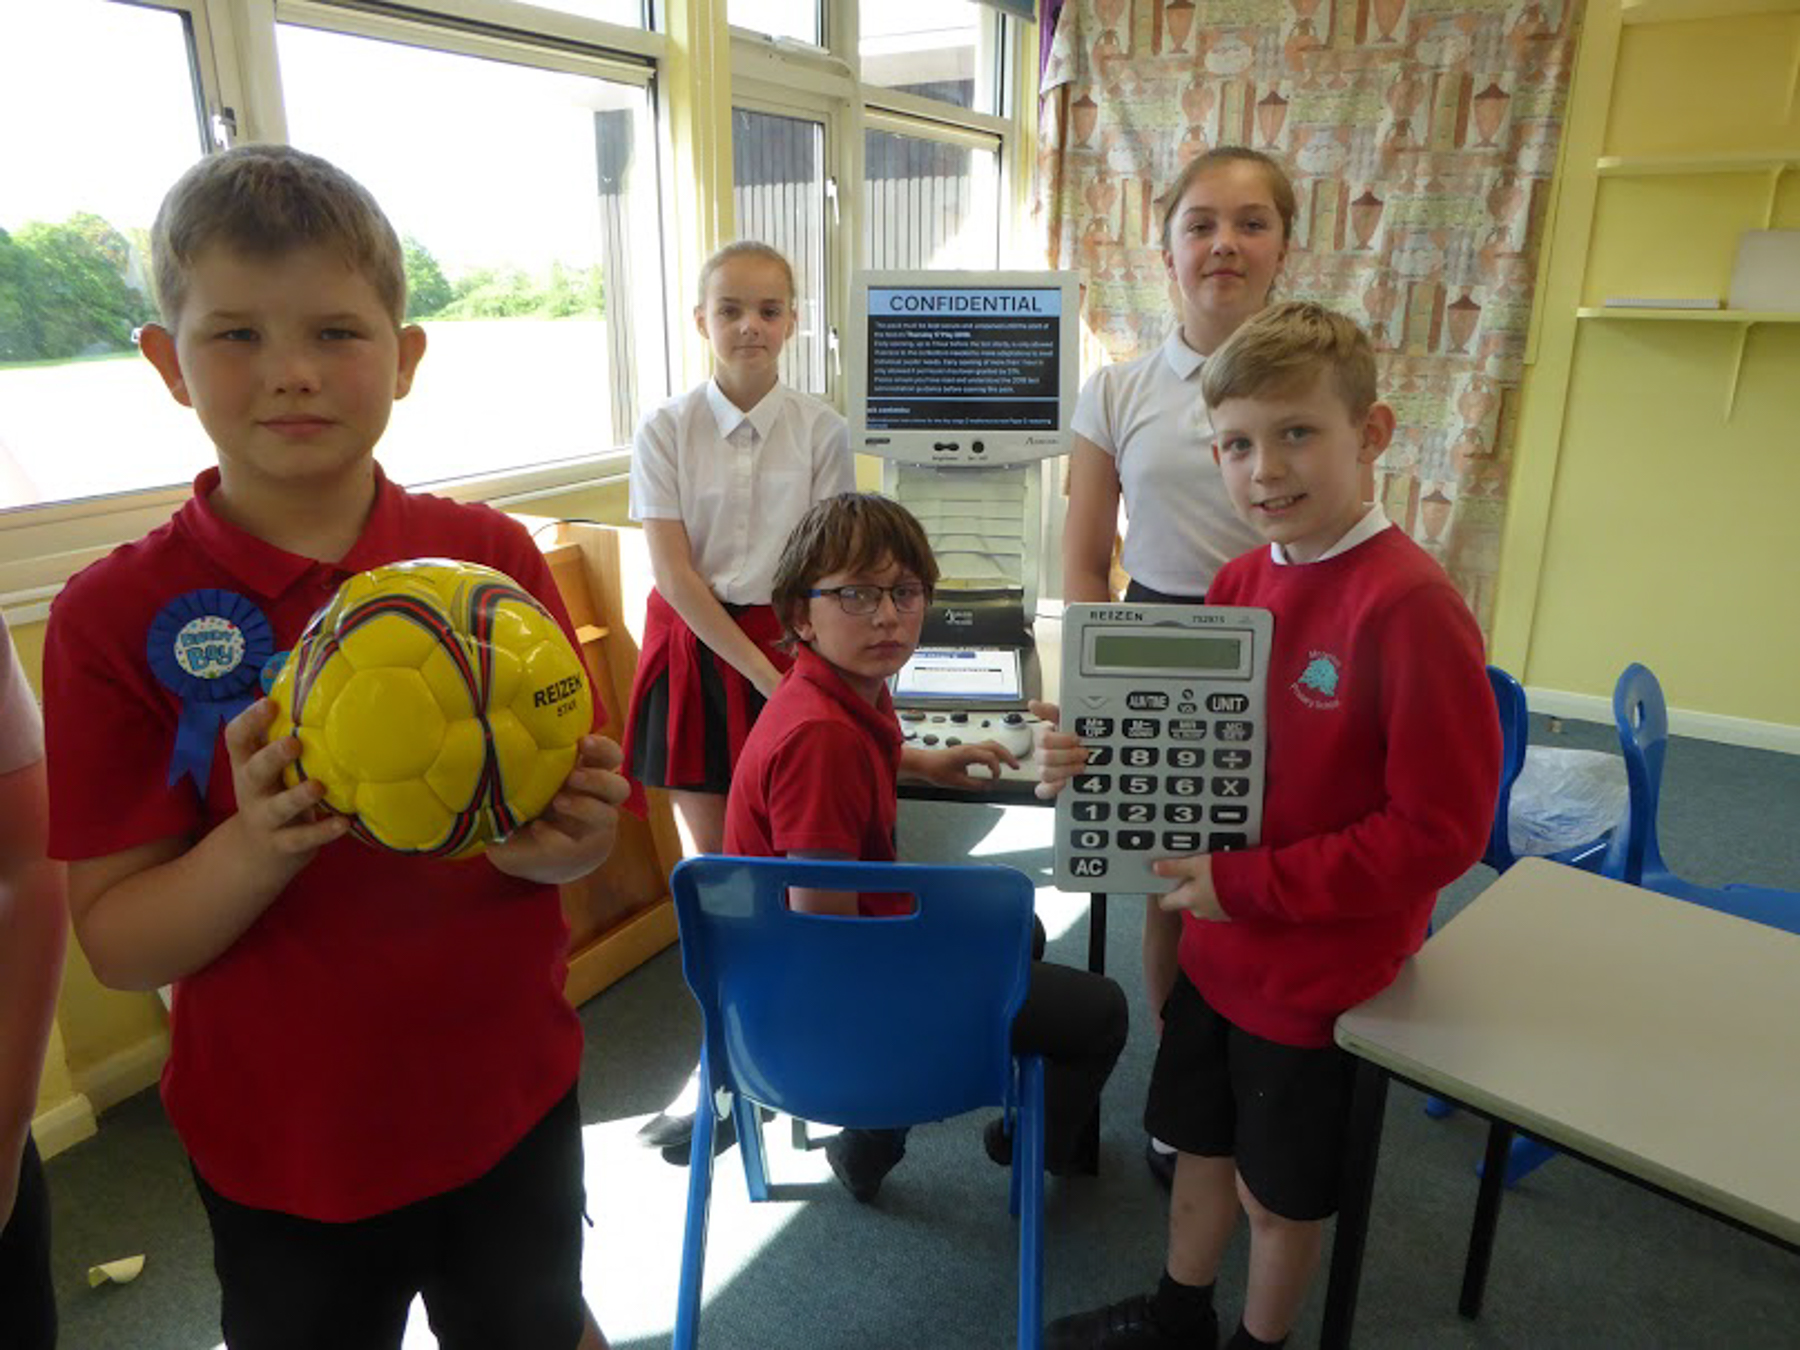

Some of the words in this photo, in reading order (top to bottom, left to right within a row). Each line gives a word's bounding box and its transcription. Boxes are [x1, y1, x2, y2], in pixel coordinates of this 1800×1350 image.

[890, 295, 1042, 312] CONFIDENTIAL
[1090, 611, 1144, 621] REIZEN
[534, 673, 582, 708] REIZEN
[1213, 697, 1244, 712] UNIT
[1088, 748, 1104, 764] 7
[1130, 749, 1150, 766] 8
[1176, 750, 1197, 767] 9
[1083, 776, 1103, 793] 4
[1129, 777, 1149, 794] 5
[1175, 778, 1195, 795] 6
[1085, 804, 1098, 820] 1
[1128, 805, 1148, 821] 2
[1173, 806, 1195, 822] 3
[1081, 832, 1100, 847] 0
[1075, 859, 1103, 876] AC
